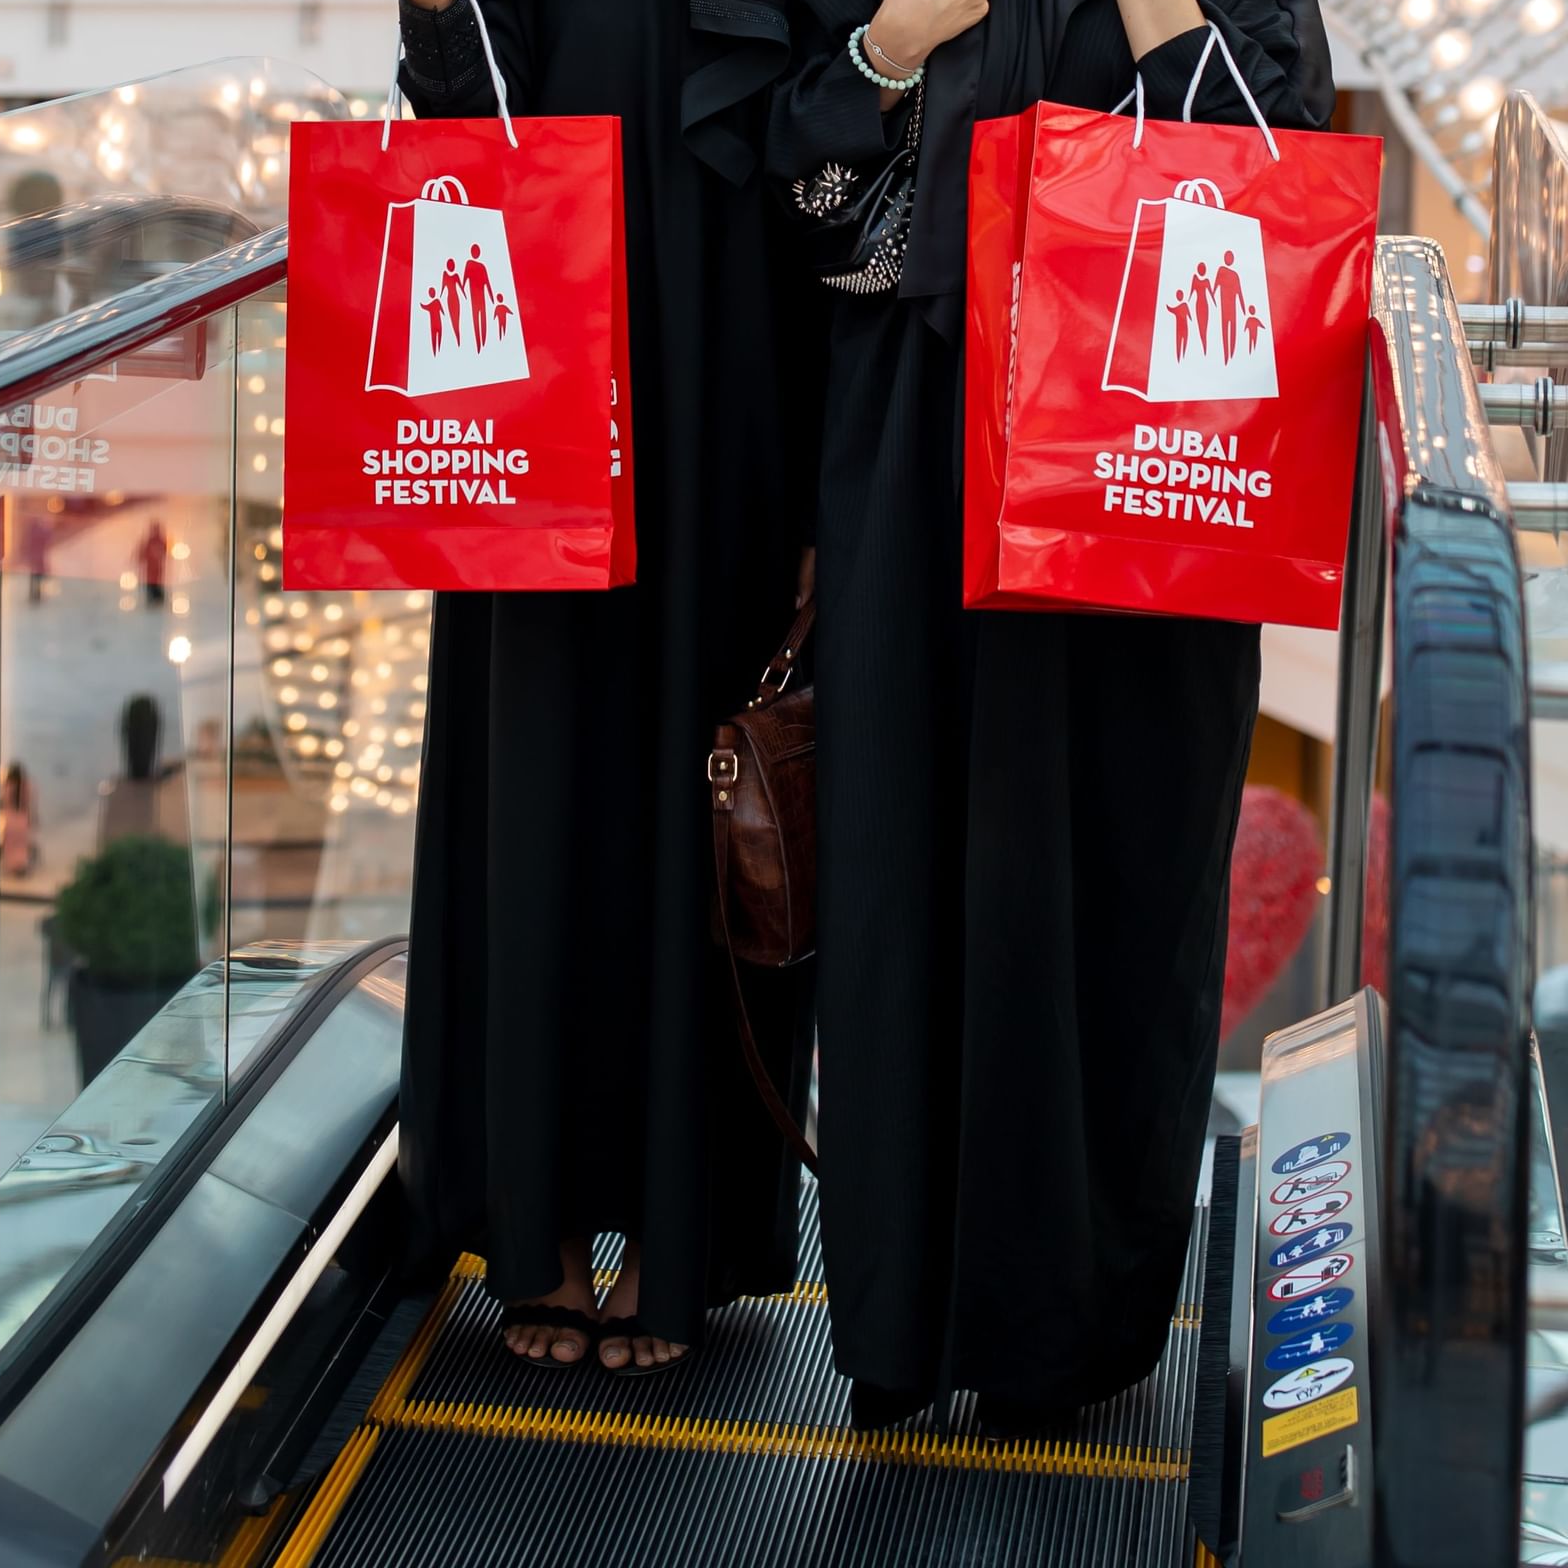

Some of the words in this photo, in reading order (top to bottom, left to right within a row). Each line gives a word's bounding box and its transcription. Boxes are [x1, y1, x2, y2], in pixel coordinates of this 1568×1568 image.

[397, 419, 494, 445] DUBAI
[1133, 424, 1238, 461] DUBAI
[362, 448, 530, 475] SHOPPING
[1093, 451, 1272, 498] SHOPPING
[374, 479, 517, 505] FESTIVAL
[1104, 484, 1254, 529] FESTIVAL
